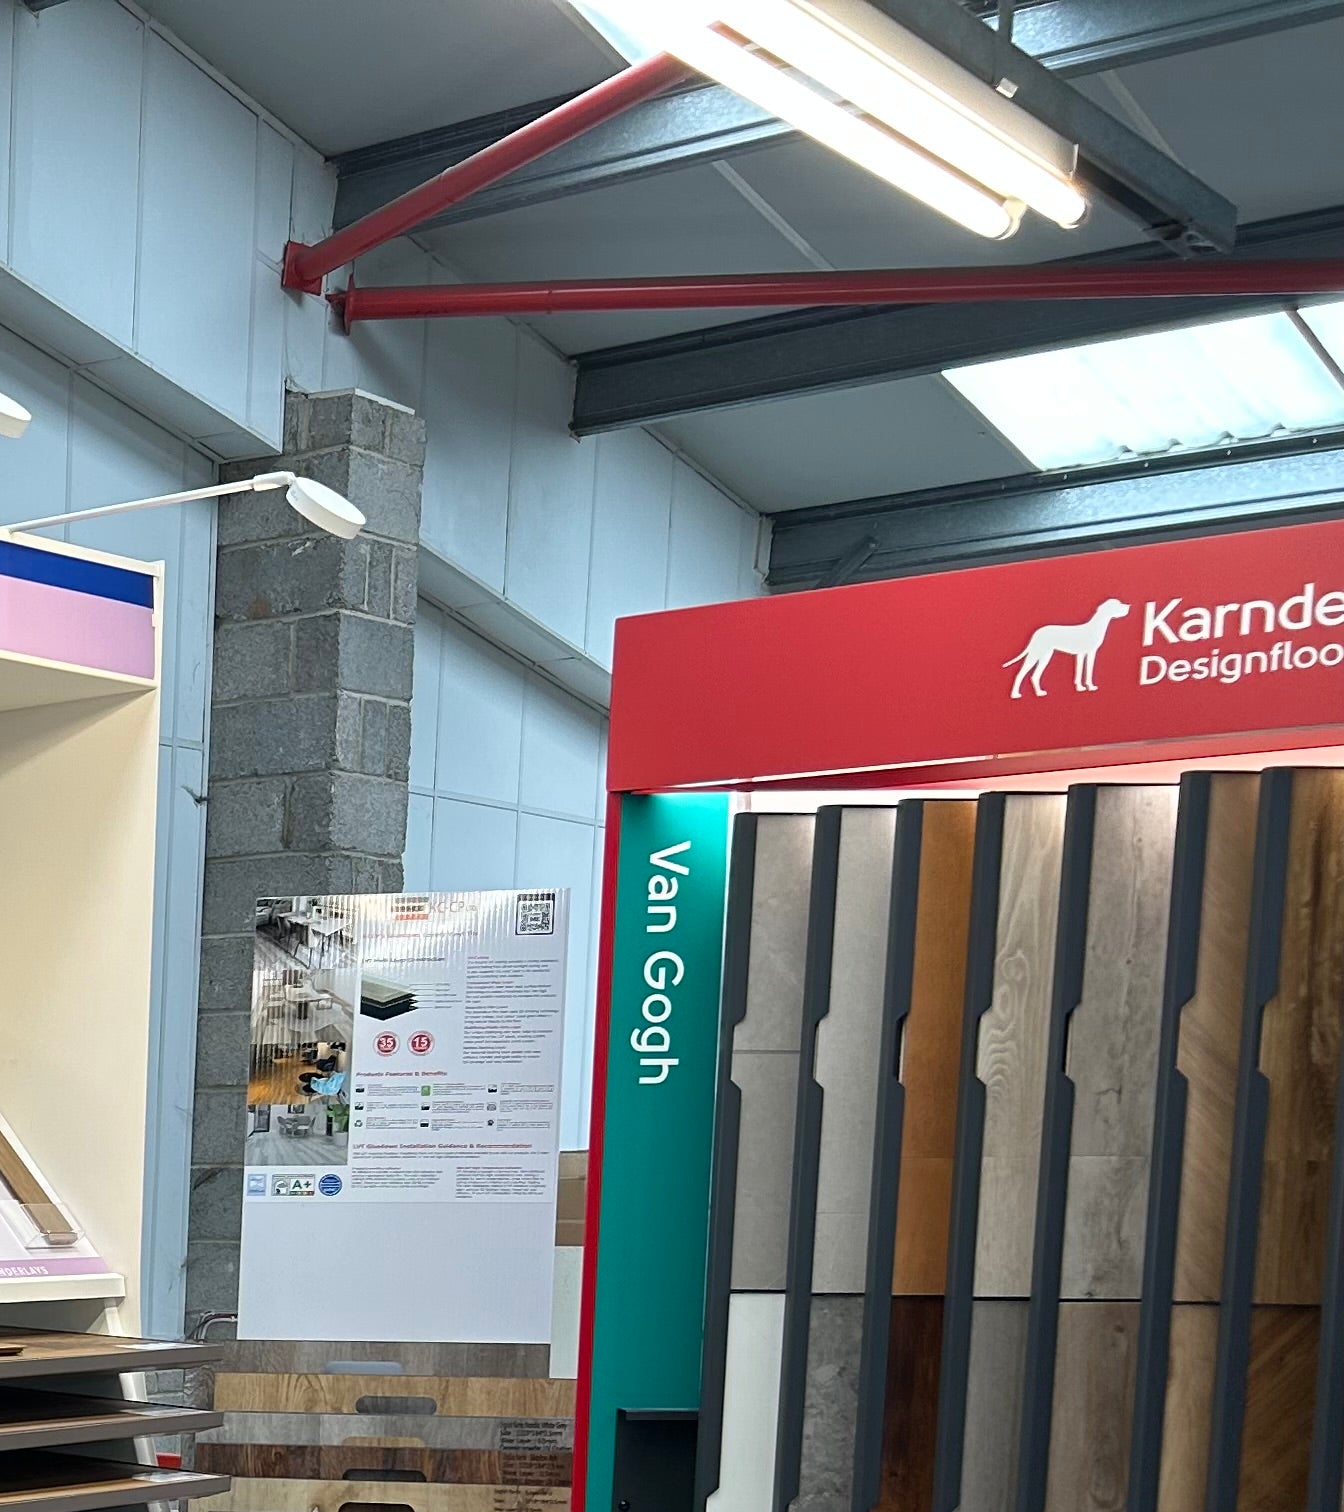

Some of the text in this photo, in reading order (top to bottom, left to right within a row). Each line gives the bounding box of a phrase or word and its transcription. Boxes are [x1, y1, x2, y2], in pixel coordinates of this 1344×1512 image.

[631, 840, 692, 1085] Van Gogh
[379, 1037, 394, 1048] 35
[414, 1036, 428, 1047] 15
[292, 1179, 312, 1190] A+
